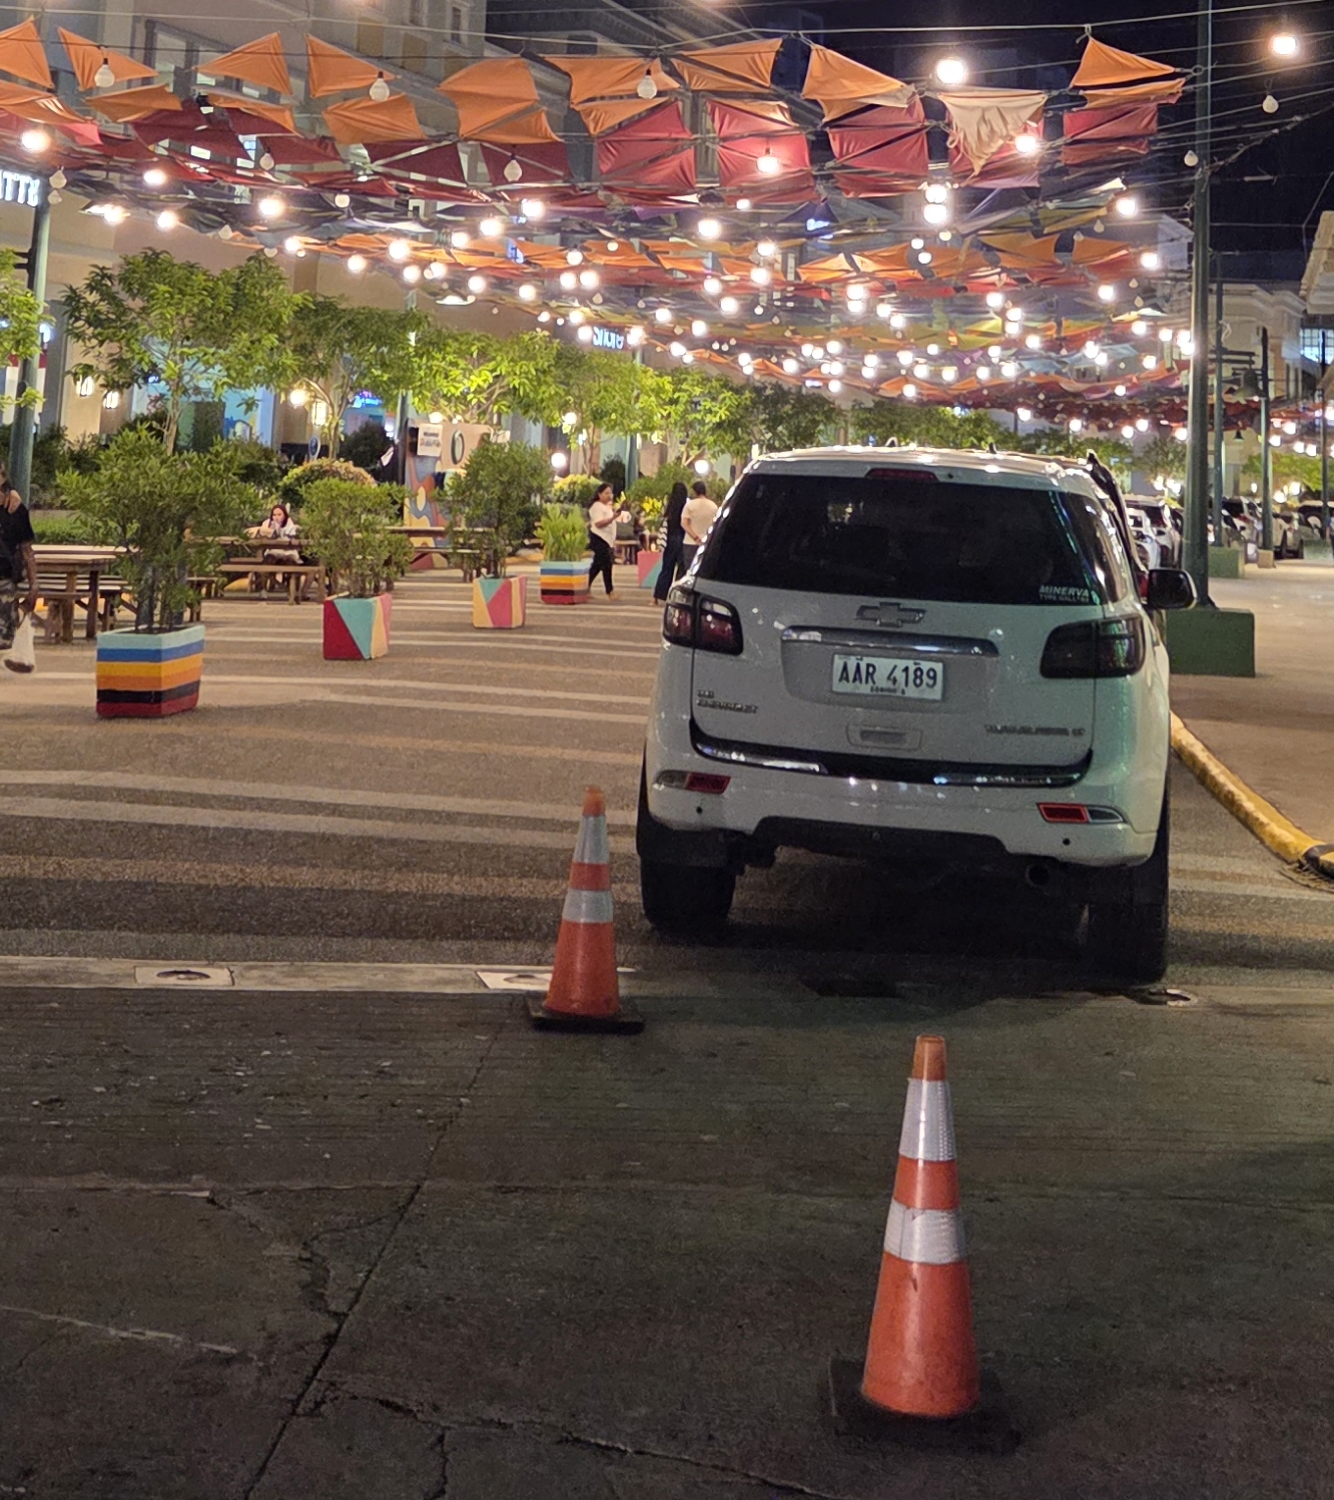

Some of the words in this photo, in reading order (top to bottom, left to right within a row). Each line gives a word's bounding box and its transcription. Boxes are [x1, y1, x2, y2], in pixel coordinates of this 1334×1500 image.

[1039, 585, 1089, 597] MINERVA
[838, 661, 877, 685] AAR
[886, 664, 938, 689] 4189
